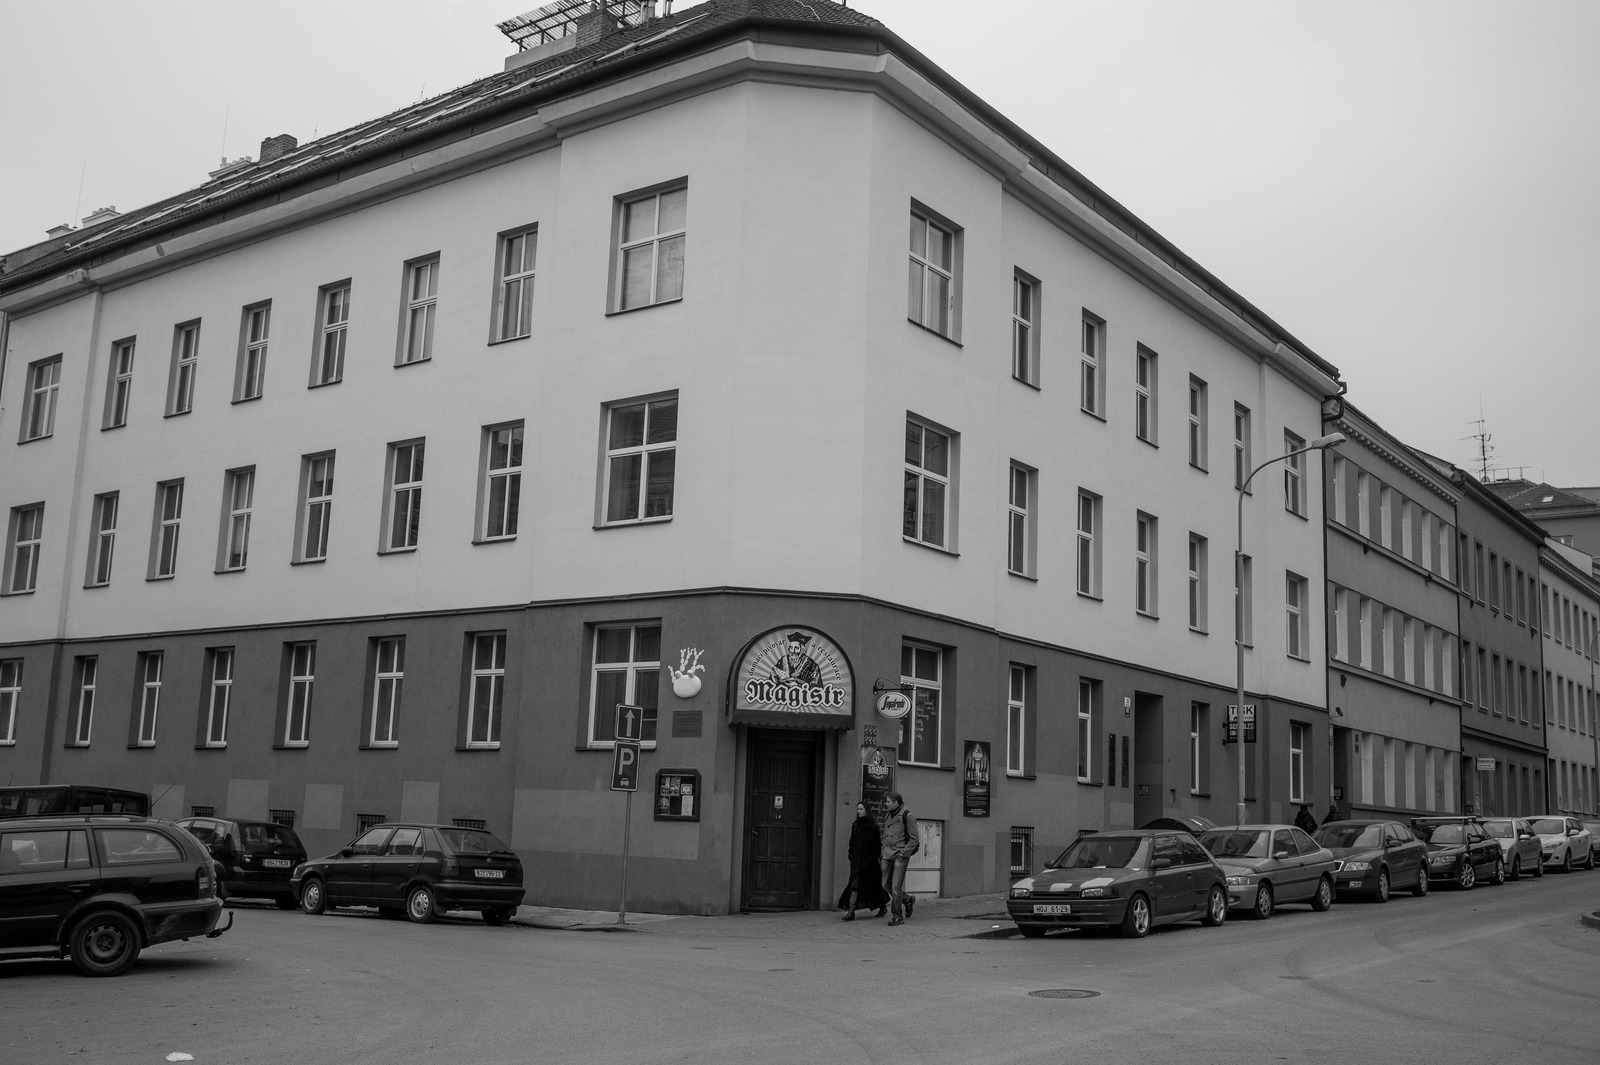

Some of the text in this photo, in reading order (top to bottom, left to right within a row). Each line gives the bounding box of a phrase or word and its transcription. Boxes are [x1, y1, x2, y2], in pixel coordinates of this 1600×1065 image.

[763, 639, 785, 656] pivovar
[817, 645, 841, 681] restaurace
[745, 679, 844, 708] Magistr
[618, 748, 634, 775] P
